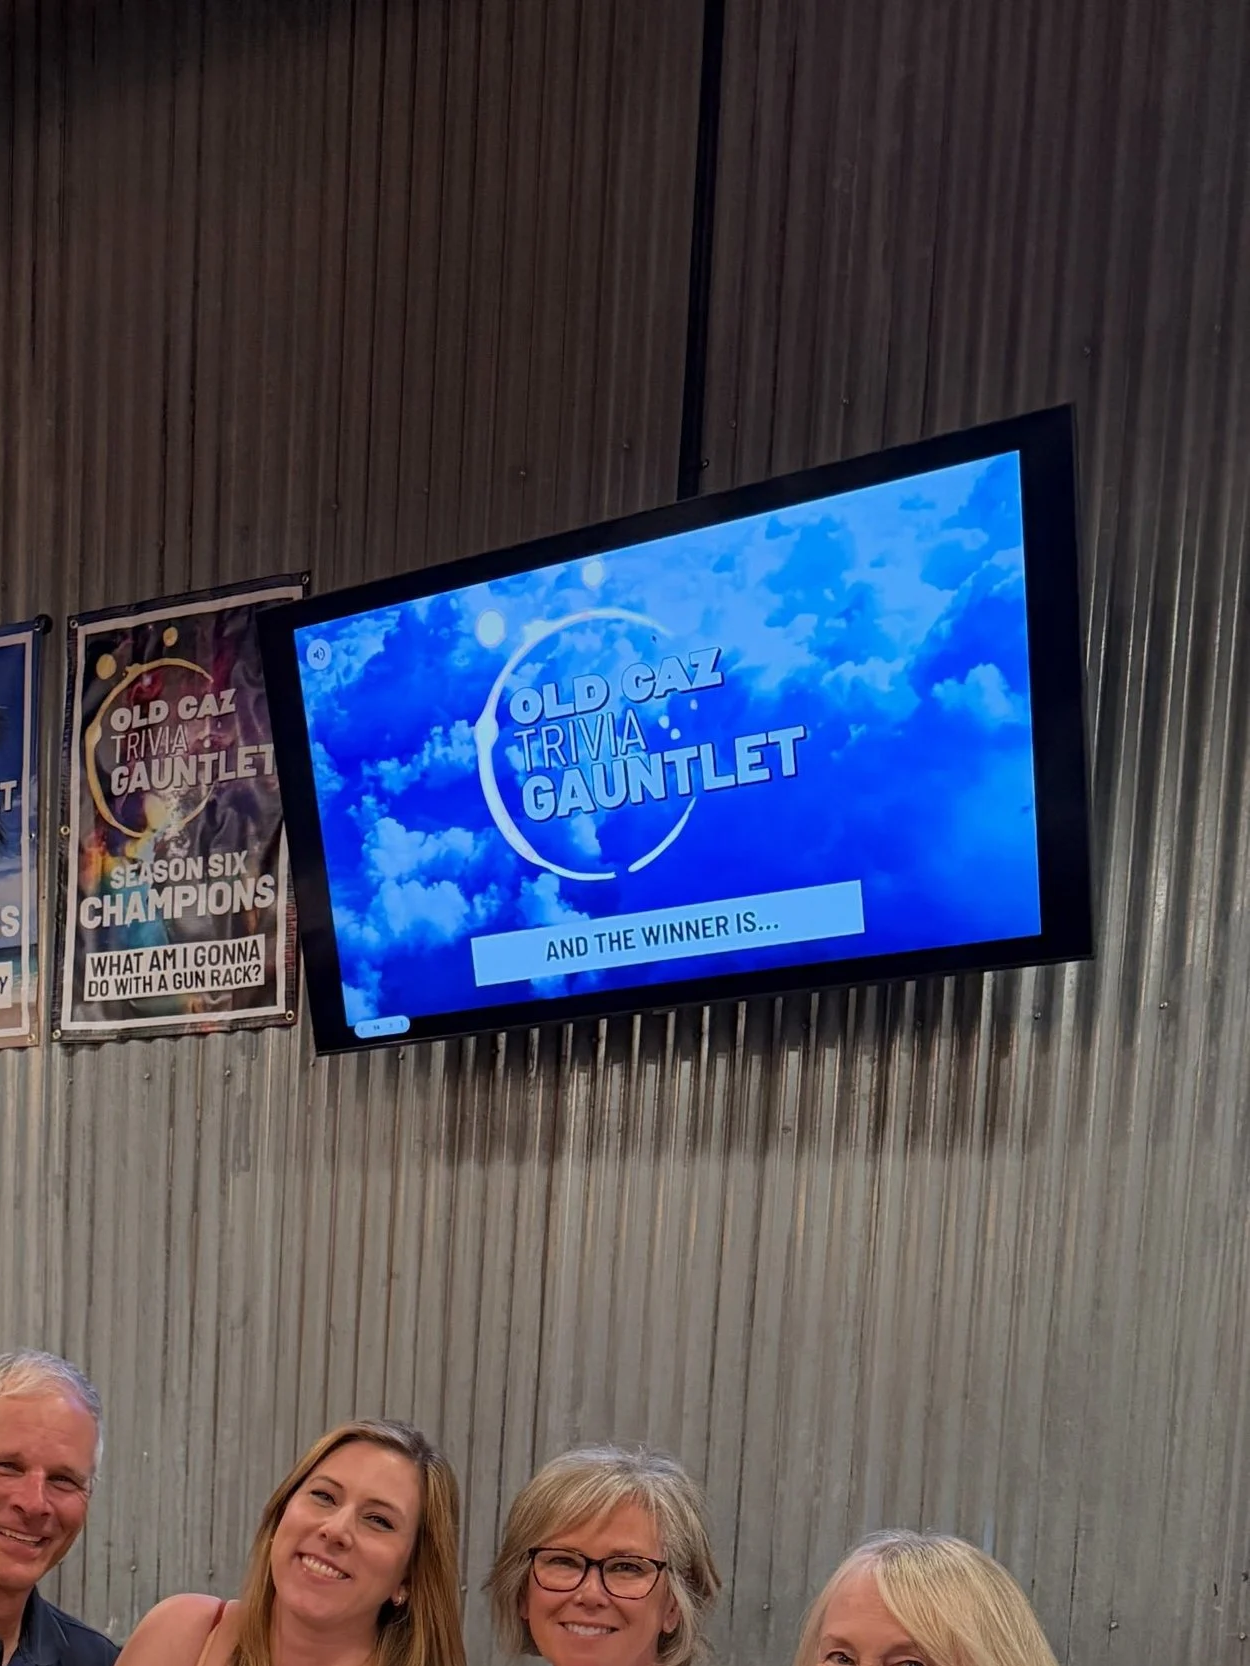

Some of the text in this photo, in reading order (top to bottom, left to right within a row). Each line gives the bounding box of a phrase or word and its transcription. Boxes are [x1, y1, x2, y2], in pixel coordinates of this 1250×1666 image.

[110, 688, 237, 733] OLD CAZ
[509, 647, 722, 725] OLD CAZ
[111, 724, 189, 764] TRIVIA
[514, 709, 647, 773] TRIVIA
[110, 744, 275, 797] GAUNTLET
[521, 725, 807, 823] GAUNTLET
[110, 850, 248, 890] SEASON SIX
[79, 874, 276, 930] CHAMPIONS
[90, 939, 261, 978] WHAT AM I GONNA
[546, 910, 779, 962] AND THE WINNER IS...
[88, 963, 262, 998] DO WITH A GUN RACK?
